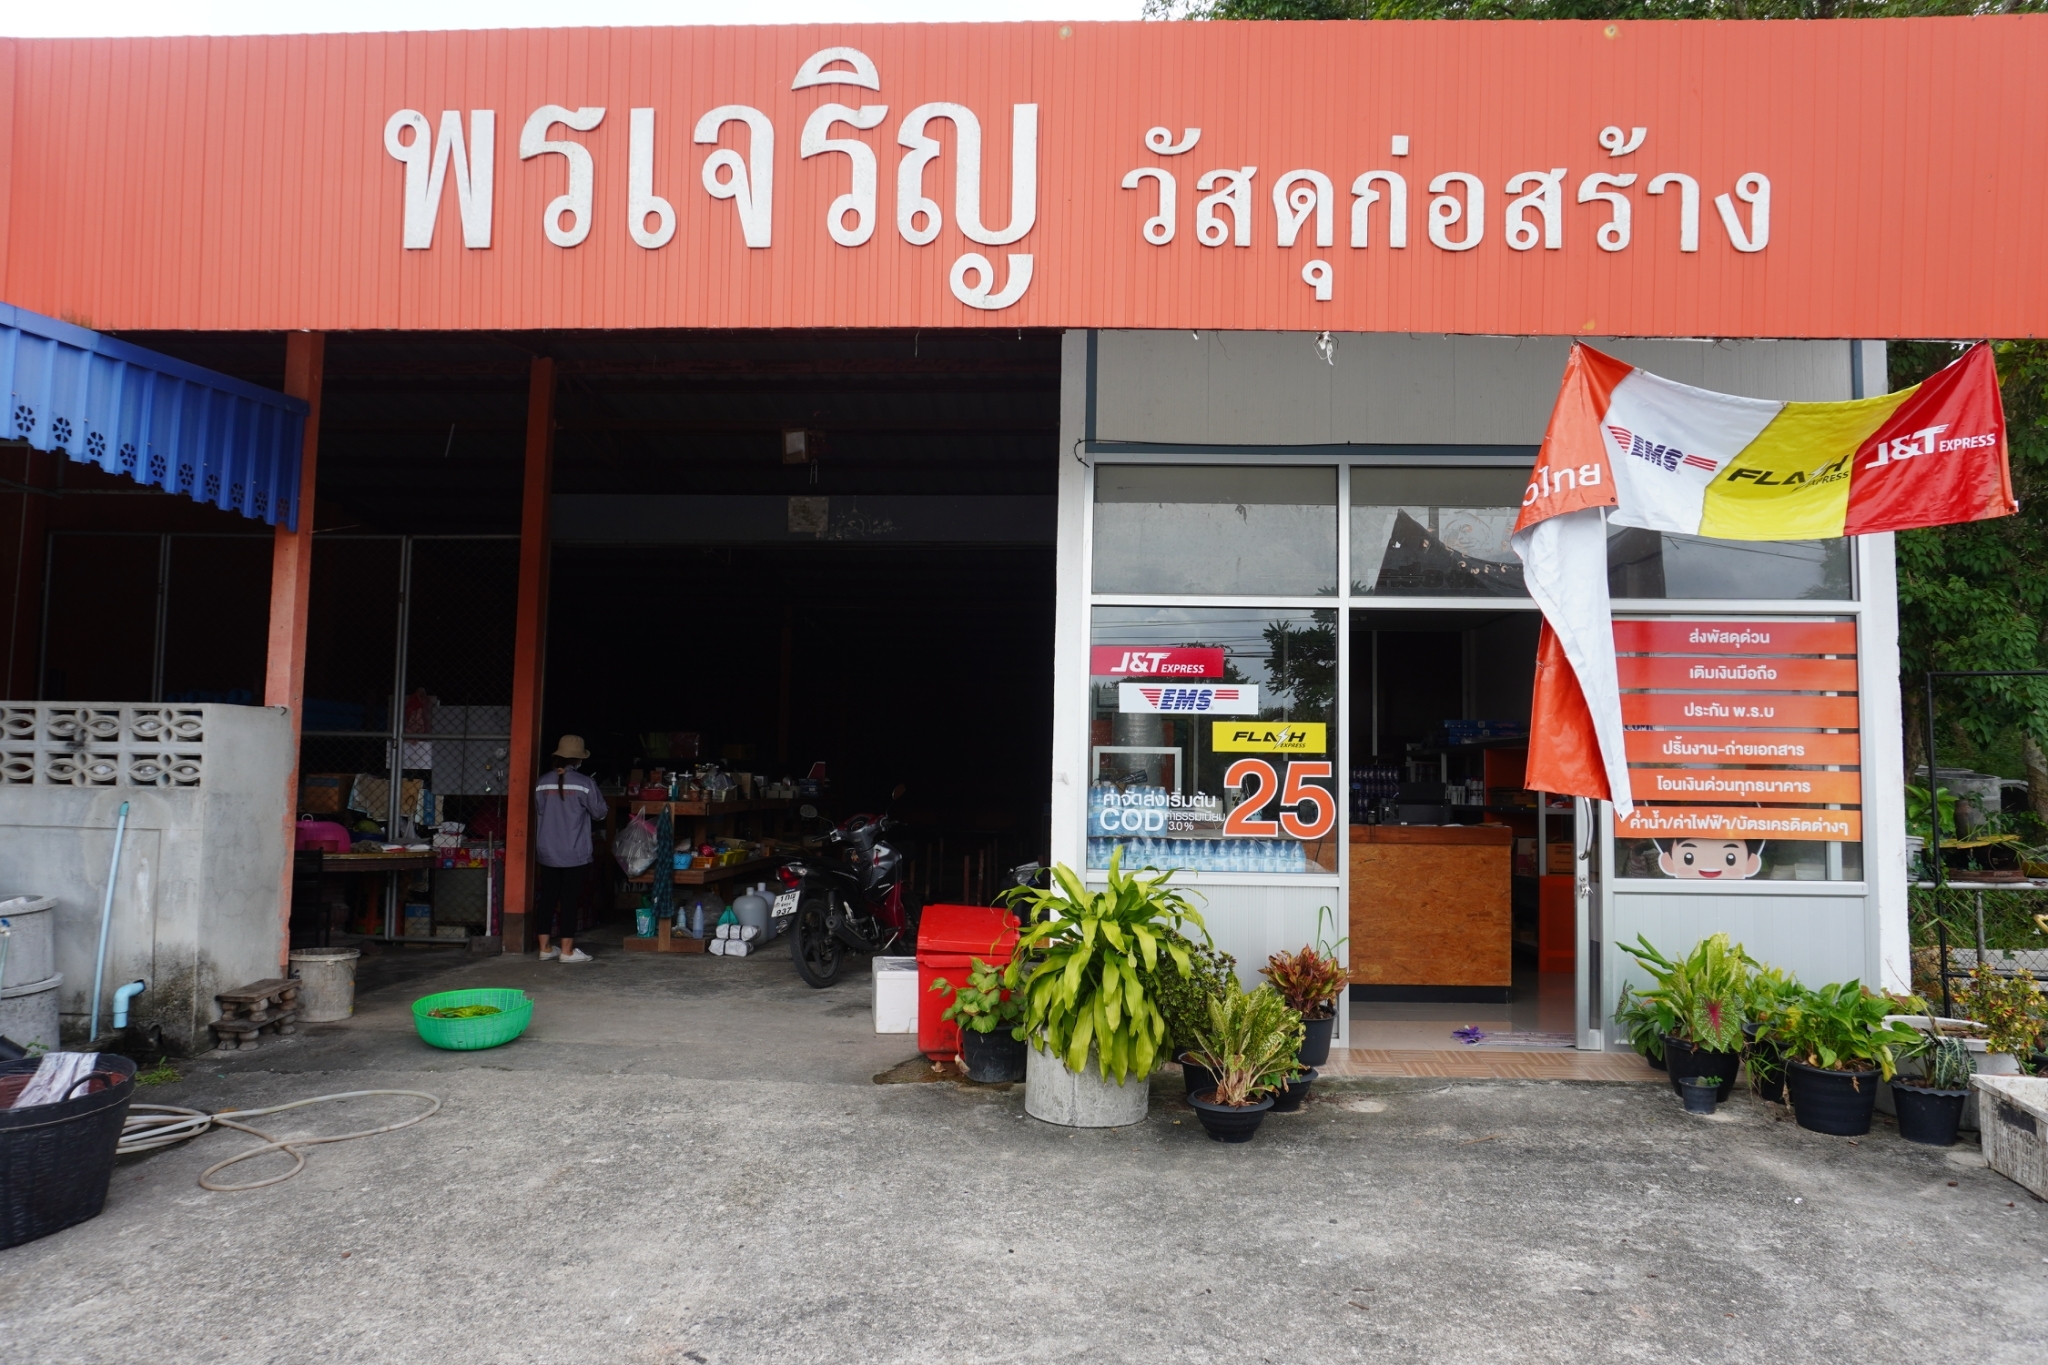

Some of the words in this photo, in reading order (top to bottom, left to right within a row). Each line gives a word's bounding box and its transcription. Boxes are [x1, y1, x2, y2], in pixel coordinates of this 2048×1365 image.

[384, 46, 1039, 310] พรเจริญ
[1121, 125, 1771, 301] วัสดุก่อสร้าง
[1631, 434, 1684, 472] EMS
[1865, 424, 1949, 469] J&T
[1939, 433, 1996, 452] EXPRESS
[1689, 628, 1770, 648] ส่งพัสดุด่วน
[1110, 652, 1171, 673] J&T
[1161, 664, 1205, 674] EXPRESS
[1689, 664, 1778, 681] เติมเงินมือถือ
[1160, 689, 1213, 710] EMS
[1684, 702, 1730, 717] ประกัน
[1733, 707, 1774, 718] พ.ร.บ
[1232, 728, 1307, 746] FLASH
[1662, 734, 1805, 757] ปริ้นงาน-ถ่ายเอกสาร
[1656, 775, 1811, 797] โอนเงินด่วนทุกธนาคาร
[1103, 788, 1216, 808] ค่าจัดส่งเริ่มต้น
[1222, 758, 1336, 840] 25
[1100, 808, 1164, 832] COD
[1164, 810, 1226, 822] ค่าธรรมเนียม
[776, 906, 792, 916] 937
